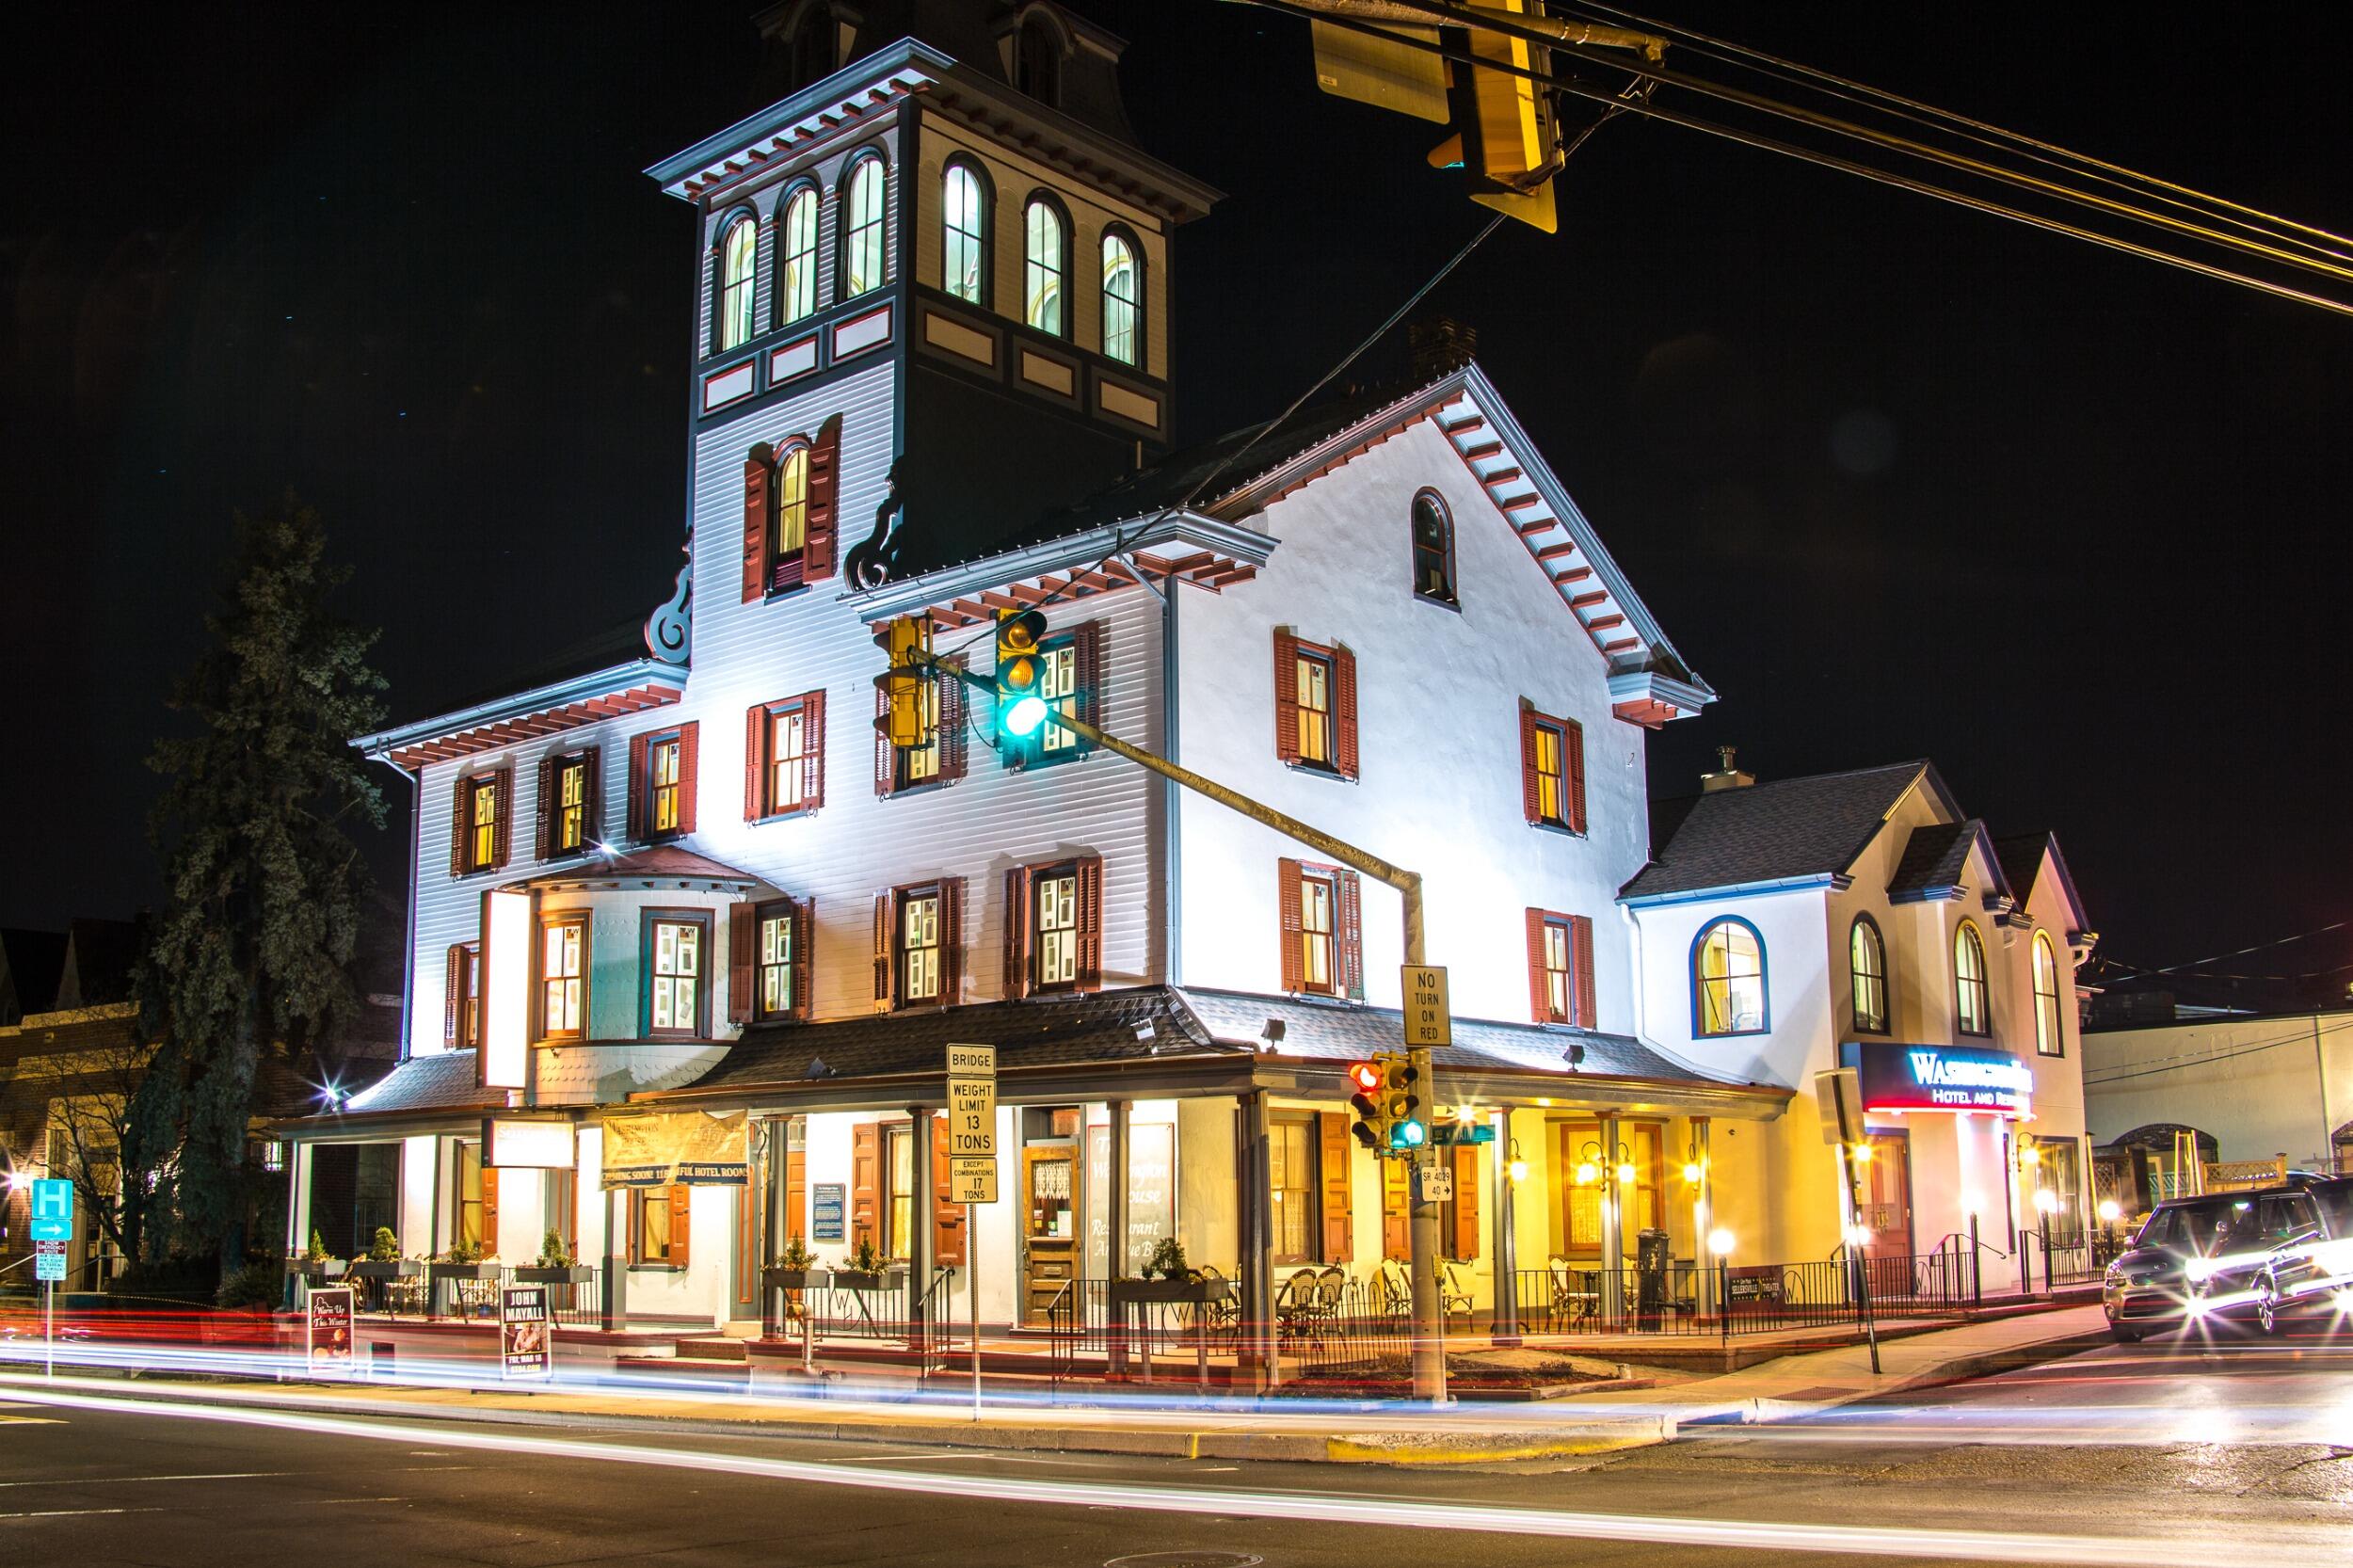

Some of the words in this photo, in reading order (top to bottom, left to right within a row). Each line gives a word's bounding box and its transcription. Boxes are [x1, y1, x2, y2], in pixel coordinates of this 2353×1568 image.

[1417, 971, 1435, 988] NO
[1415, 992, 1439, 1005] TURN
[1421, 1010, 1434, 1022] ON
[1420, 1027, 1438, 1040] RED
[952, 1053, 991, 1066] BRIDGE
[953, 1083, 992, 1096] WEIGHT
[958, 1099, 985, 1112] LIMIT
[967, 1114, 980, 1130] 13
[955, 1134, 991, 1149] TONS
[695, 1166, 720, 1177] HOTEL
[1422, 1172, 1432, 1182] SR
[1433, 1172, 1450, 1182] 4029
[973, 1177, 983, 1190] 17
[1432, 1185, 1441, 1195] 40
[39, 1181, 67, 1217] H
[963, 1190, 985, 1200] TONS
[511, 1290, 537, 1306] JOHN
[317, 1305, 334, 1315] Warm
[334, 1304, 345, 1317] Up
[505, 1306, 544, 1322] MAYALL
[328, 1317, 348, 1326] Winter
